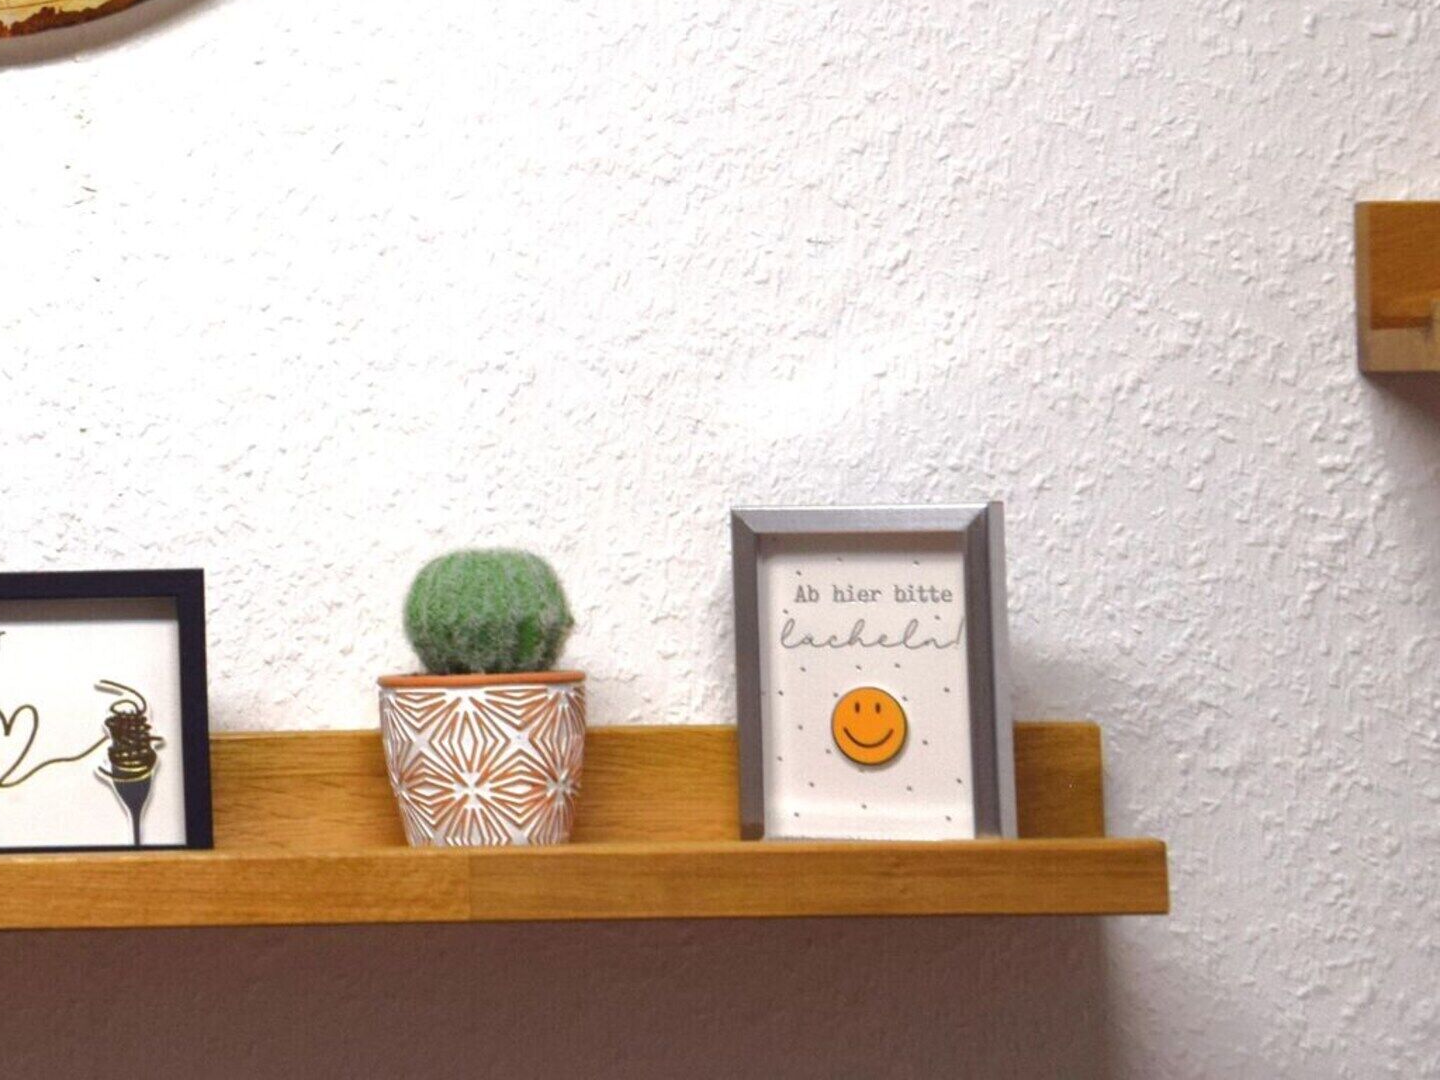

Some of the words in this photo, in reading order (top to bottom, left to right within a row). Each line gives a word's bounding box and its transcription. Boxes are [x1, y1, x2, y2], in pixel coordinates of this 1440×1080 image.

[794, 585, 820, 603] Ab
[832, 584, 882, 603] hier
[894, 584, 953, 603] bitte
